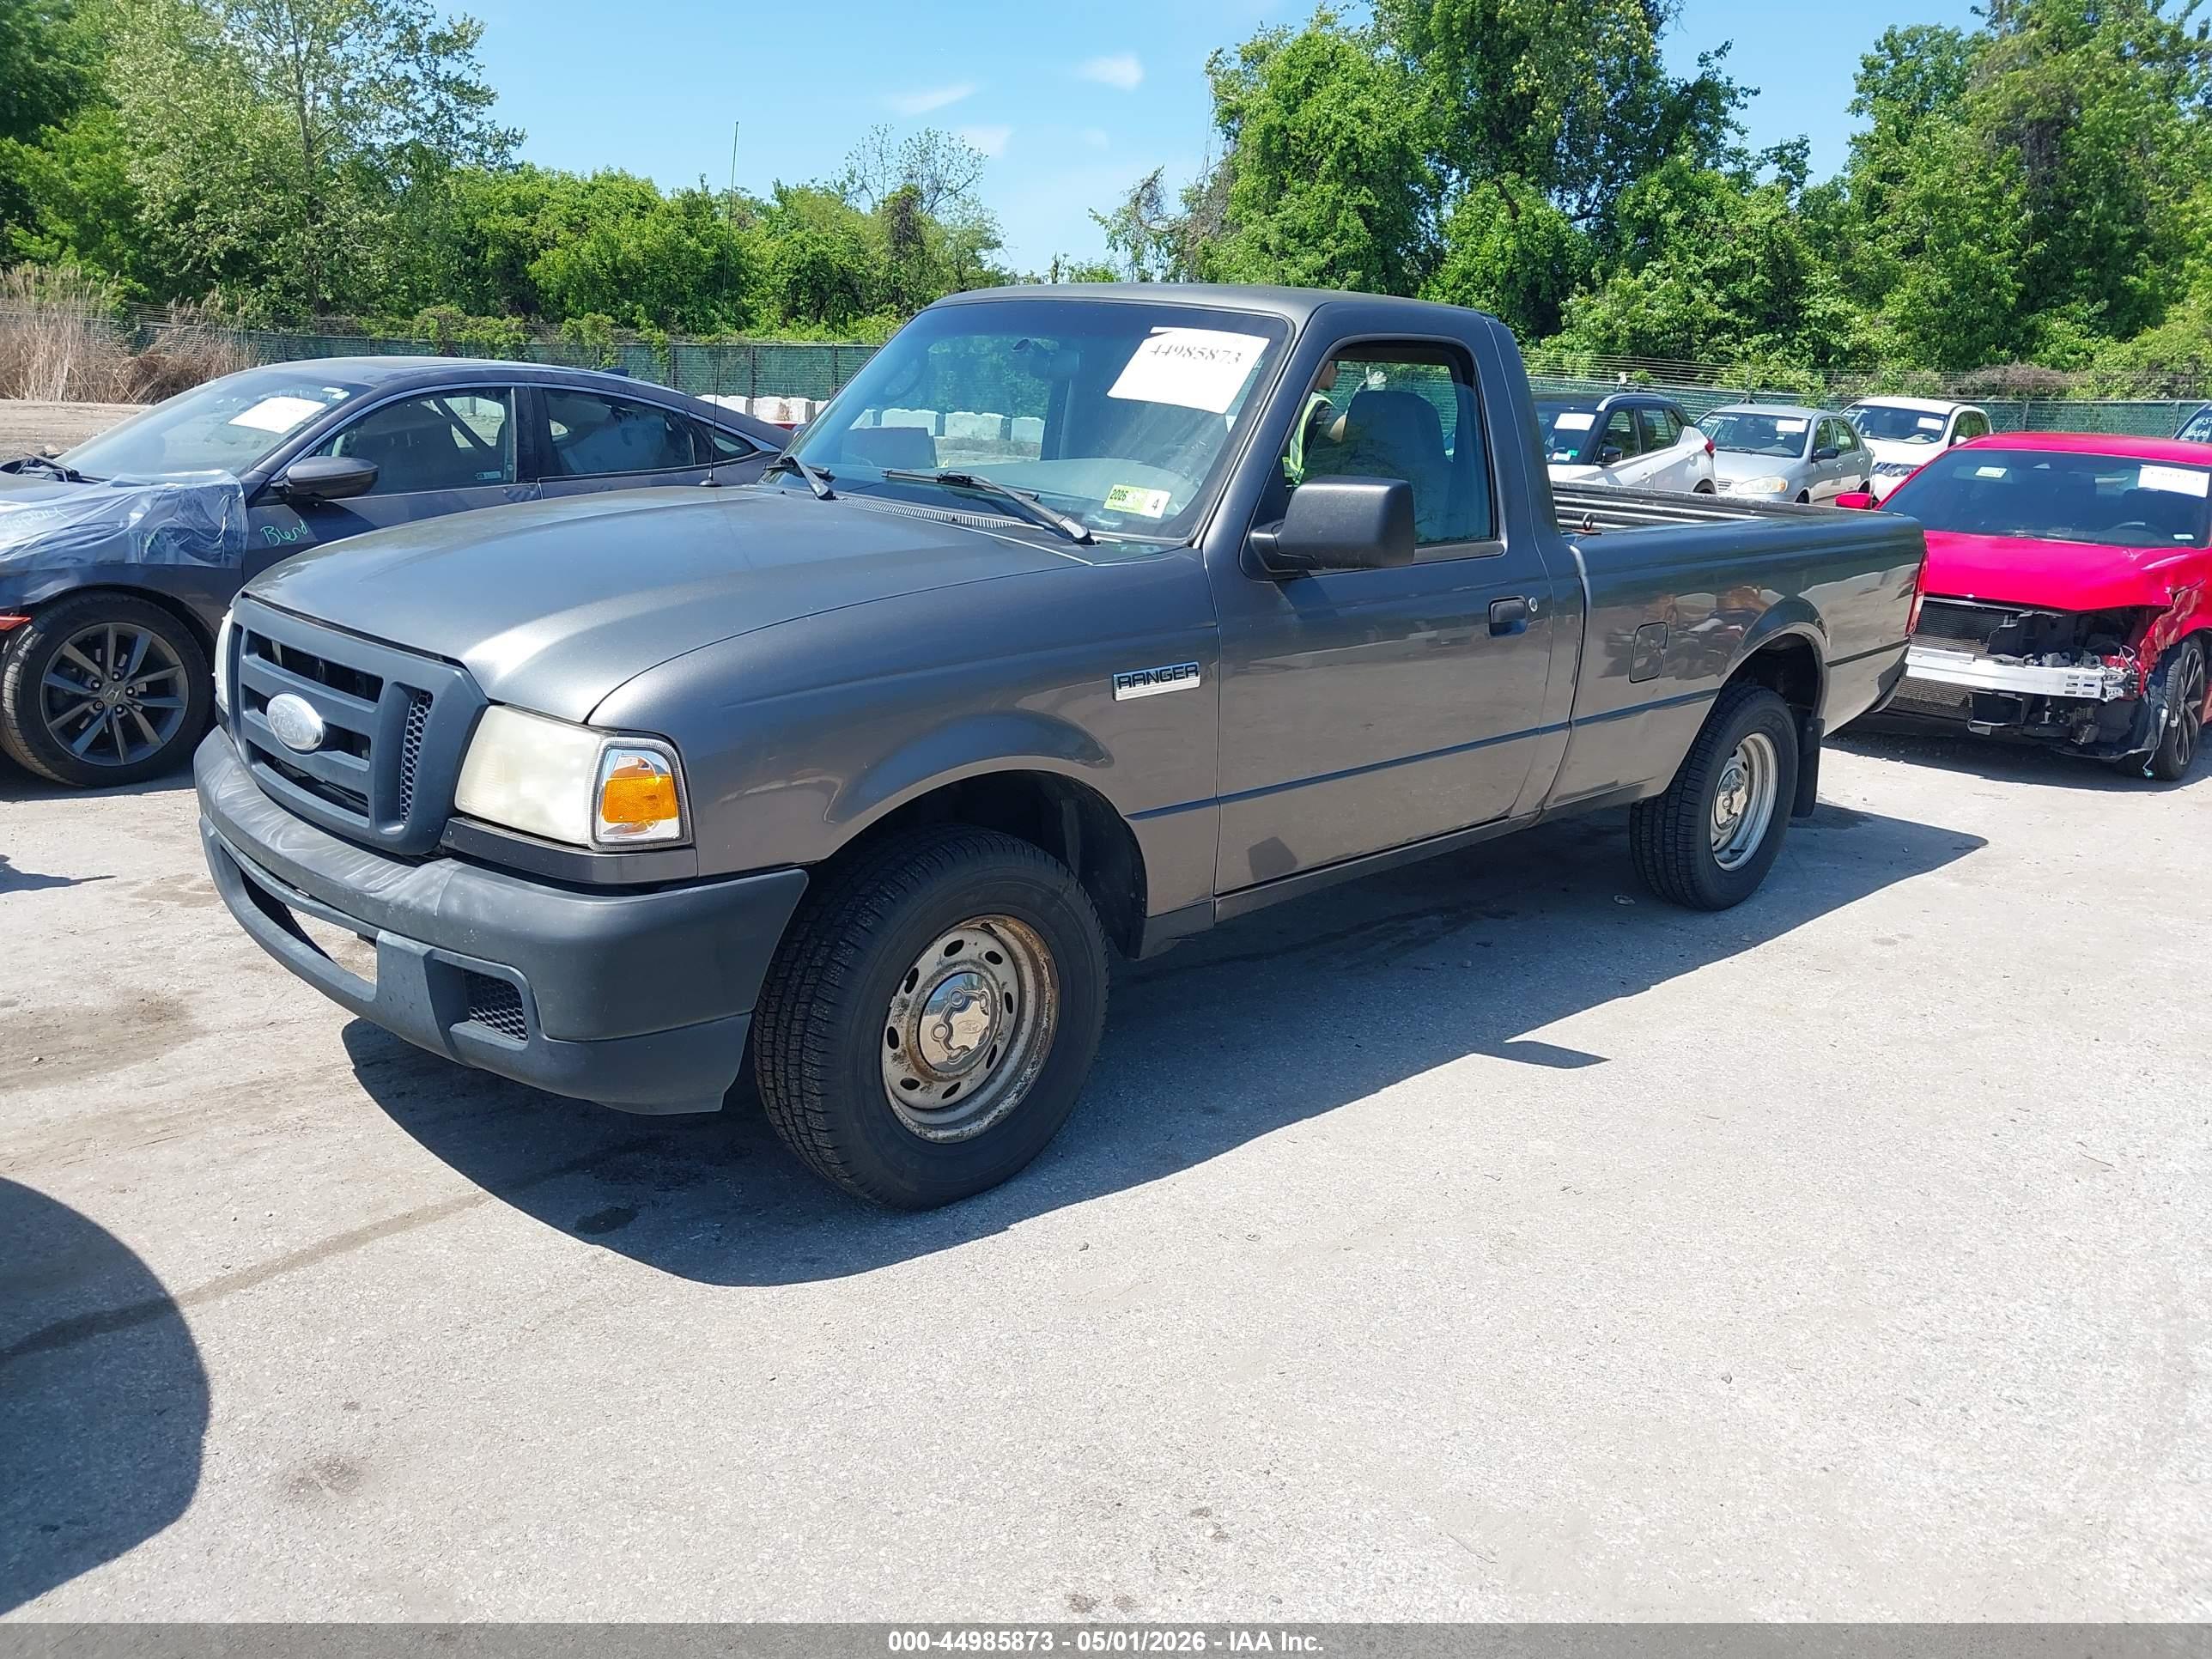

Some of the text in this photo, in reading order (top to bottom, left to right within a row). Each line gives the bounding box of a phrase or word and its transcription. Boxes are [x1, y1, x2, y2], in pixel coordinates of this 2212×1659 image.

[1149, 343, 1242, 365] 44985873
[1152, 498, 1160, 511] 4
[259, 518, 308, 546] Blend
[1117, 663, 1200, 690] RANGER
